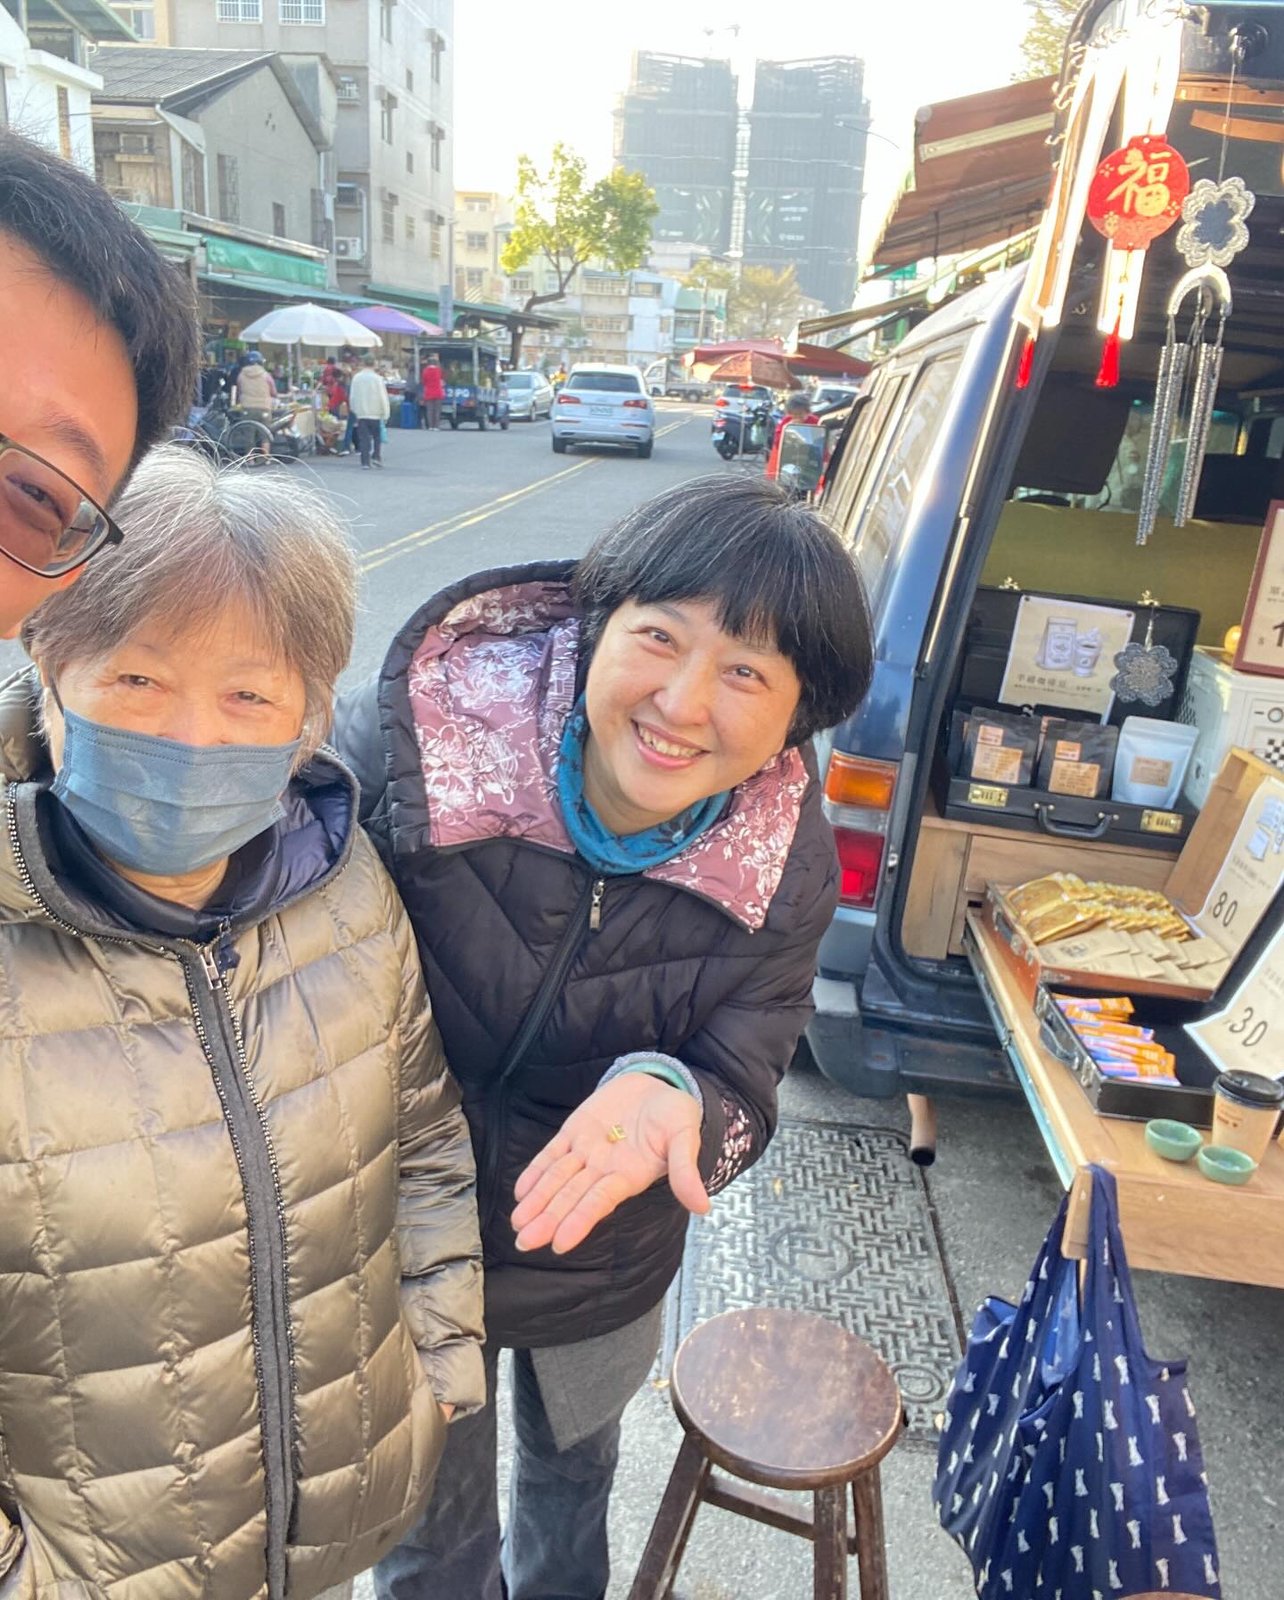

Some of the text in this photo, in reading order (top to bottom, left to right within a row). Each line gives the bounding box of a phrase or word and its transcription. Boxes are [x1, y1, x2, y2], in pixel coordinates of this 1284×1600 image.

[1106, 147, 1172, 217] 福
[1213, 890, 1238, 928] 80
[1228, 1006, 1268, 1047] 30
